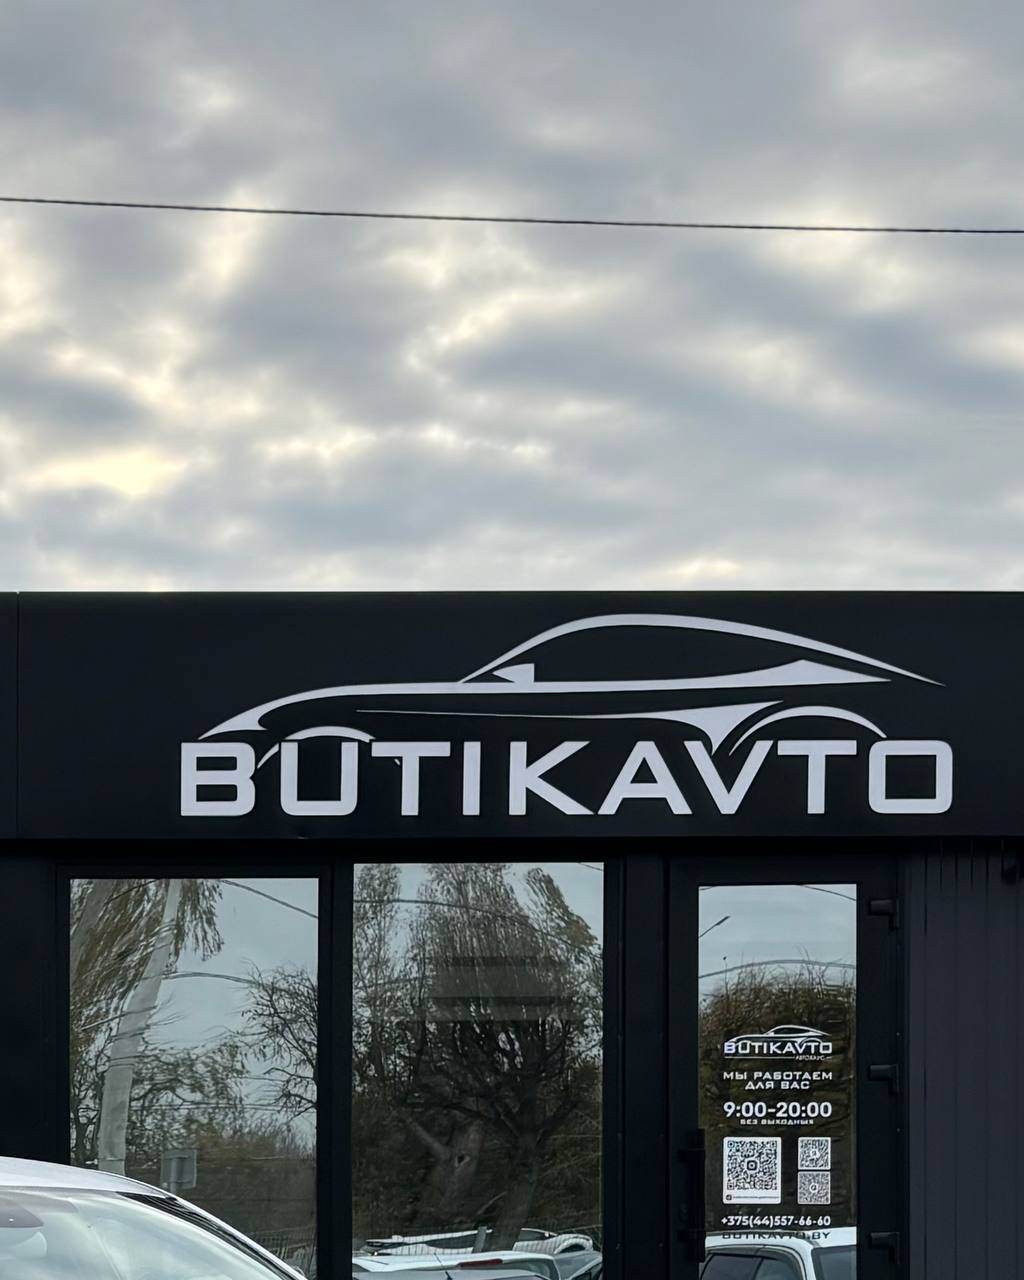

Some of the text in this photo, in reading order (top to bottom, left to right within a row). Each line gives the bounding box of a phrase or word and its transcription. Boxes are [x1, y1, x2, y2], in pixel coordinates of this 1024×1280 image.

[180, 739, 954, 817] BUTIKAVTO
[723, 1041, 833, 1054] BUTIKAVTO
[723, 1072, 833, 1080] МЫ РАБОТАЕМ
[745, 1081, 810, 1090] ДЛЯ ВАС
[723, 1101, 833, 1118] 9:00-20:00
[721, 1215, 831, 1228] +375(44)557-66-60
